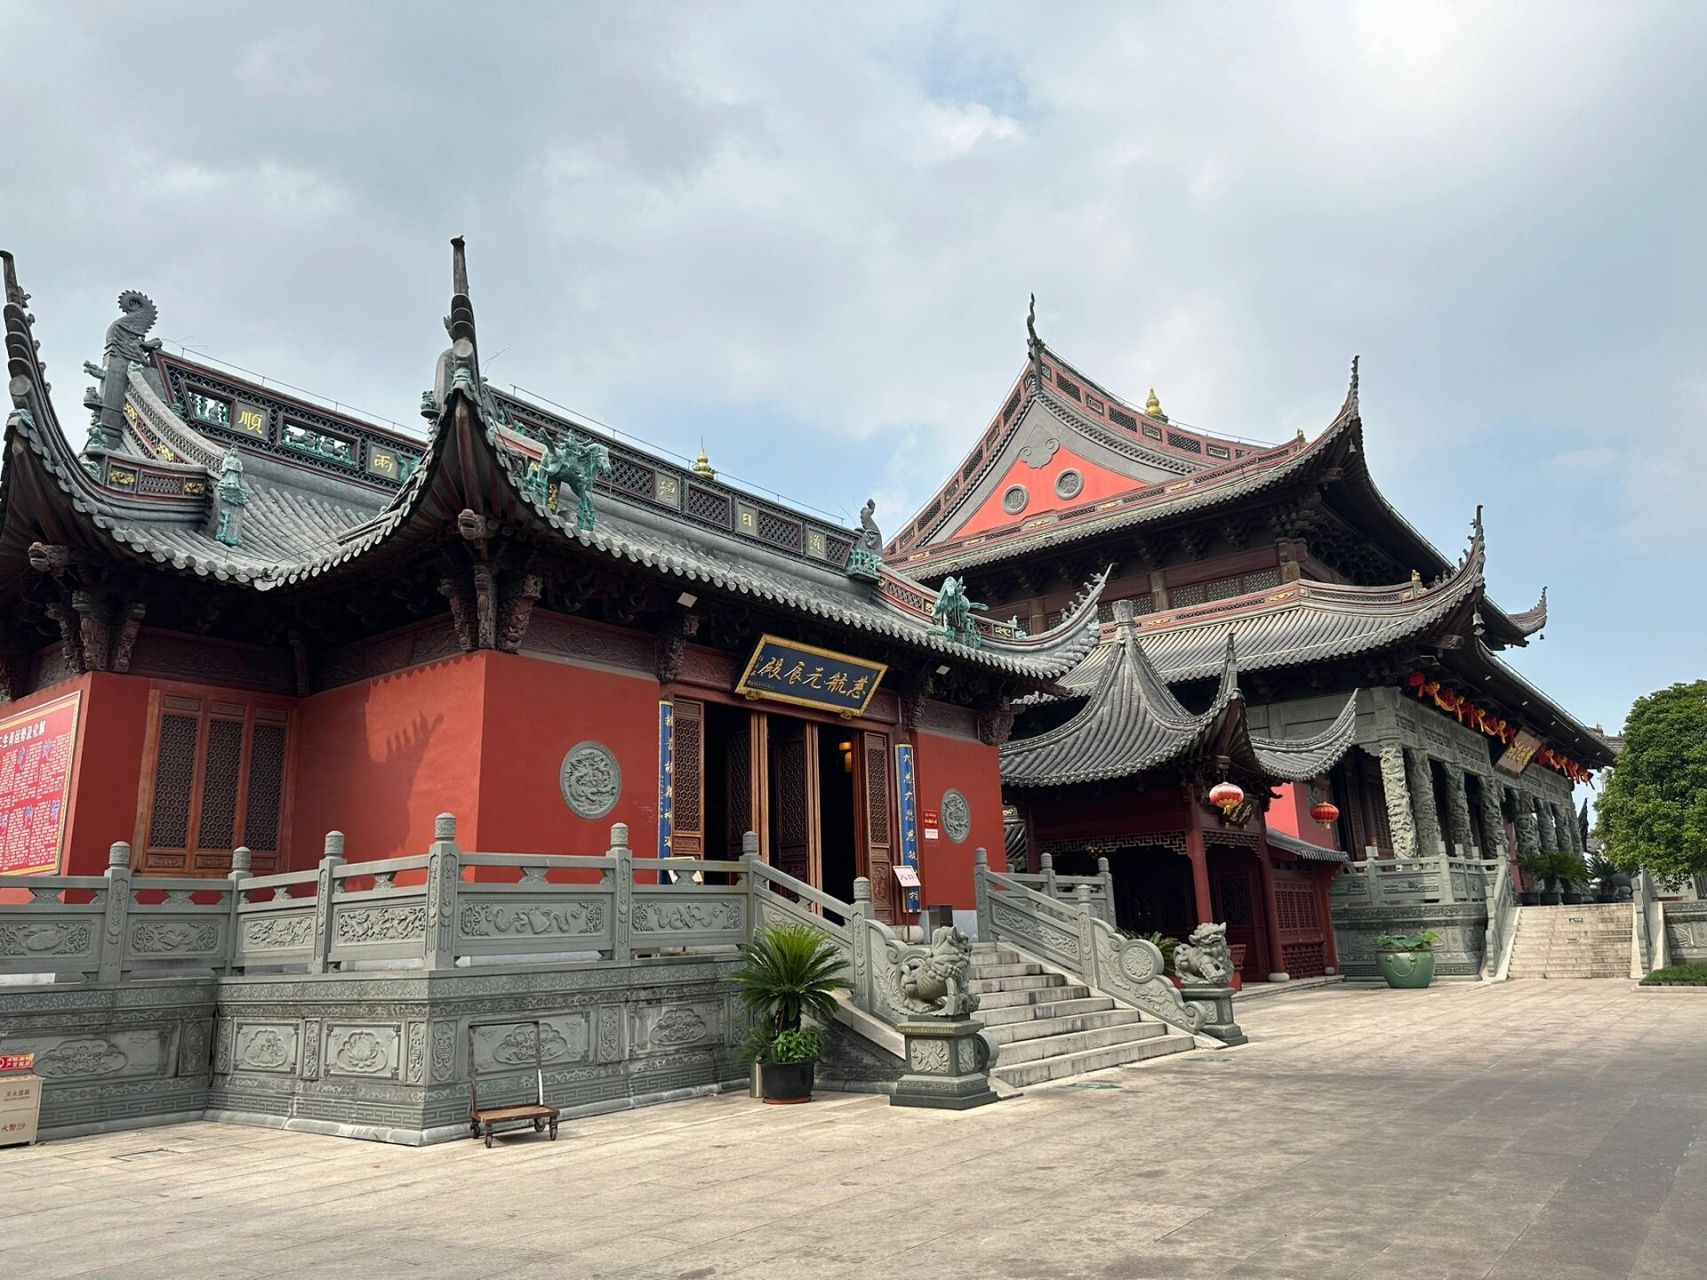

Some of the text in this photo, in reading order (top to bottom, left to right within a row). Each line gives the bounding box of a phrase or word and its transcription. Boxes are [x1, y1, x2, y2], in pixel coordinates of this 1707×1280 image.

[238, 410, 393, 472] 順 雨
[742, 512, 752, 527] 日
[809, 534, 822, 555] 道
